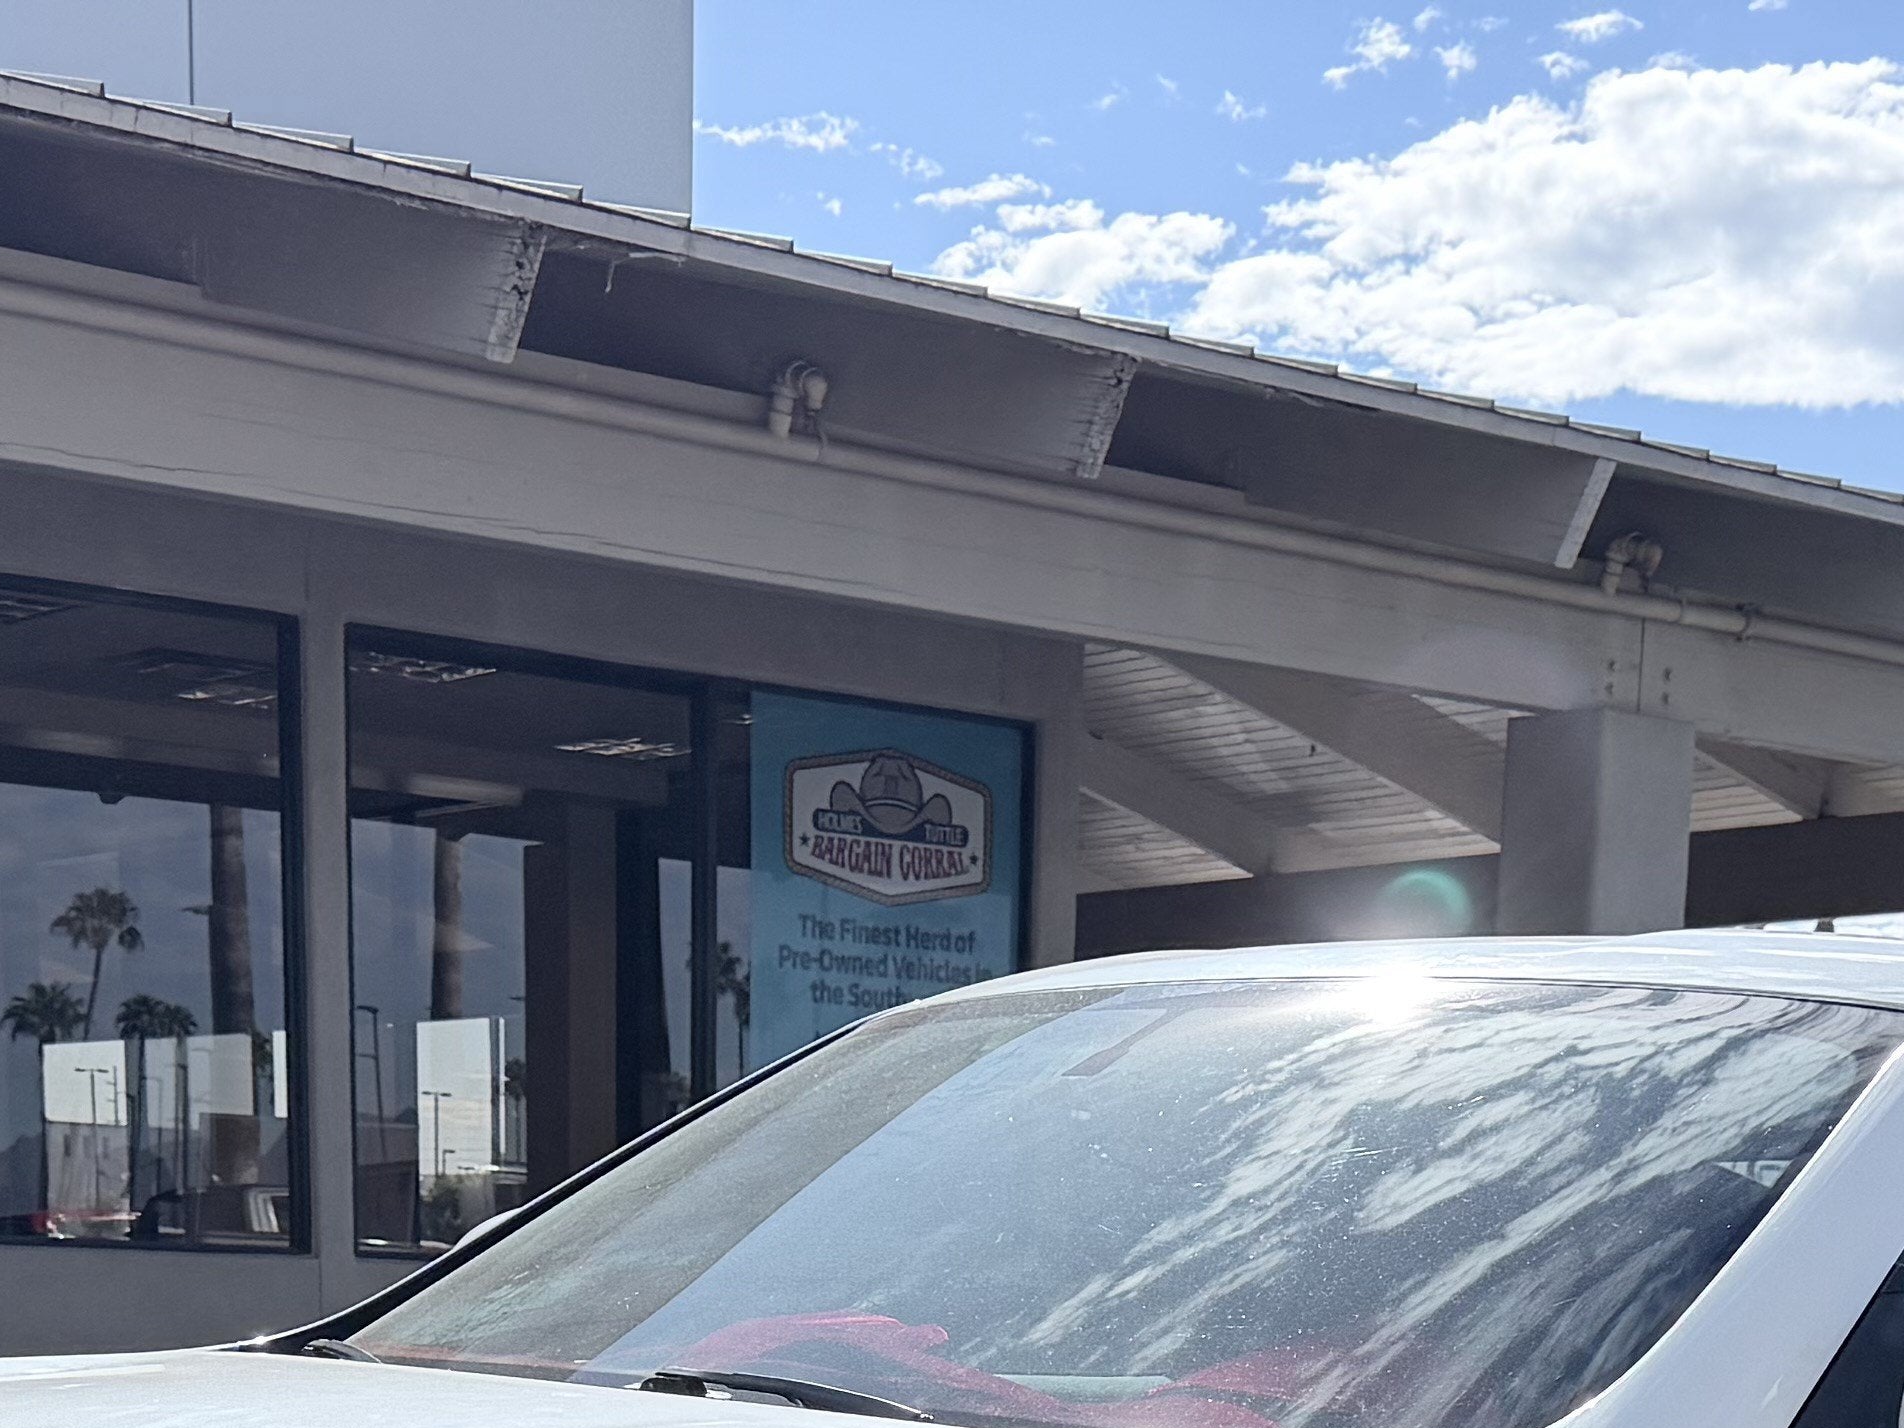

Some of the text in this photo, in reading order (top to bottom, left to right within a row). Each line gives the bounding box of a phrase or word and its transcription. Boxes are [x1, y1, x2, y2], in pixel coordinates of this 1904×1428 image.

[811, 834, 970, 881] BARGAIN CORRAL
[799, 912, 976, 955] The Finest Herd of
[778, 943, 888, 979] Pre-Owned
[893, 953, 971, 985] Vehicles
[810, 978, 844, 1004] the
